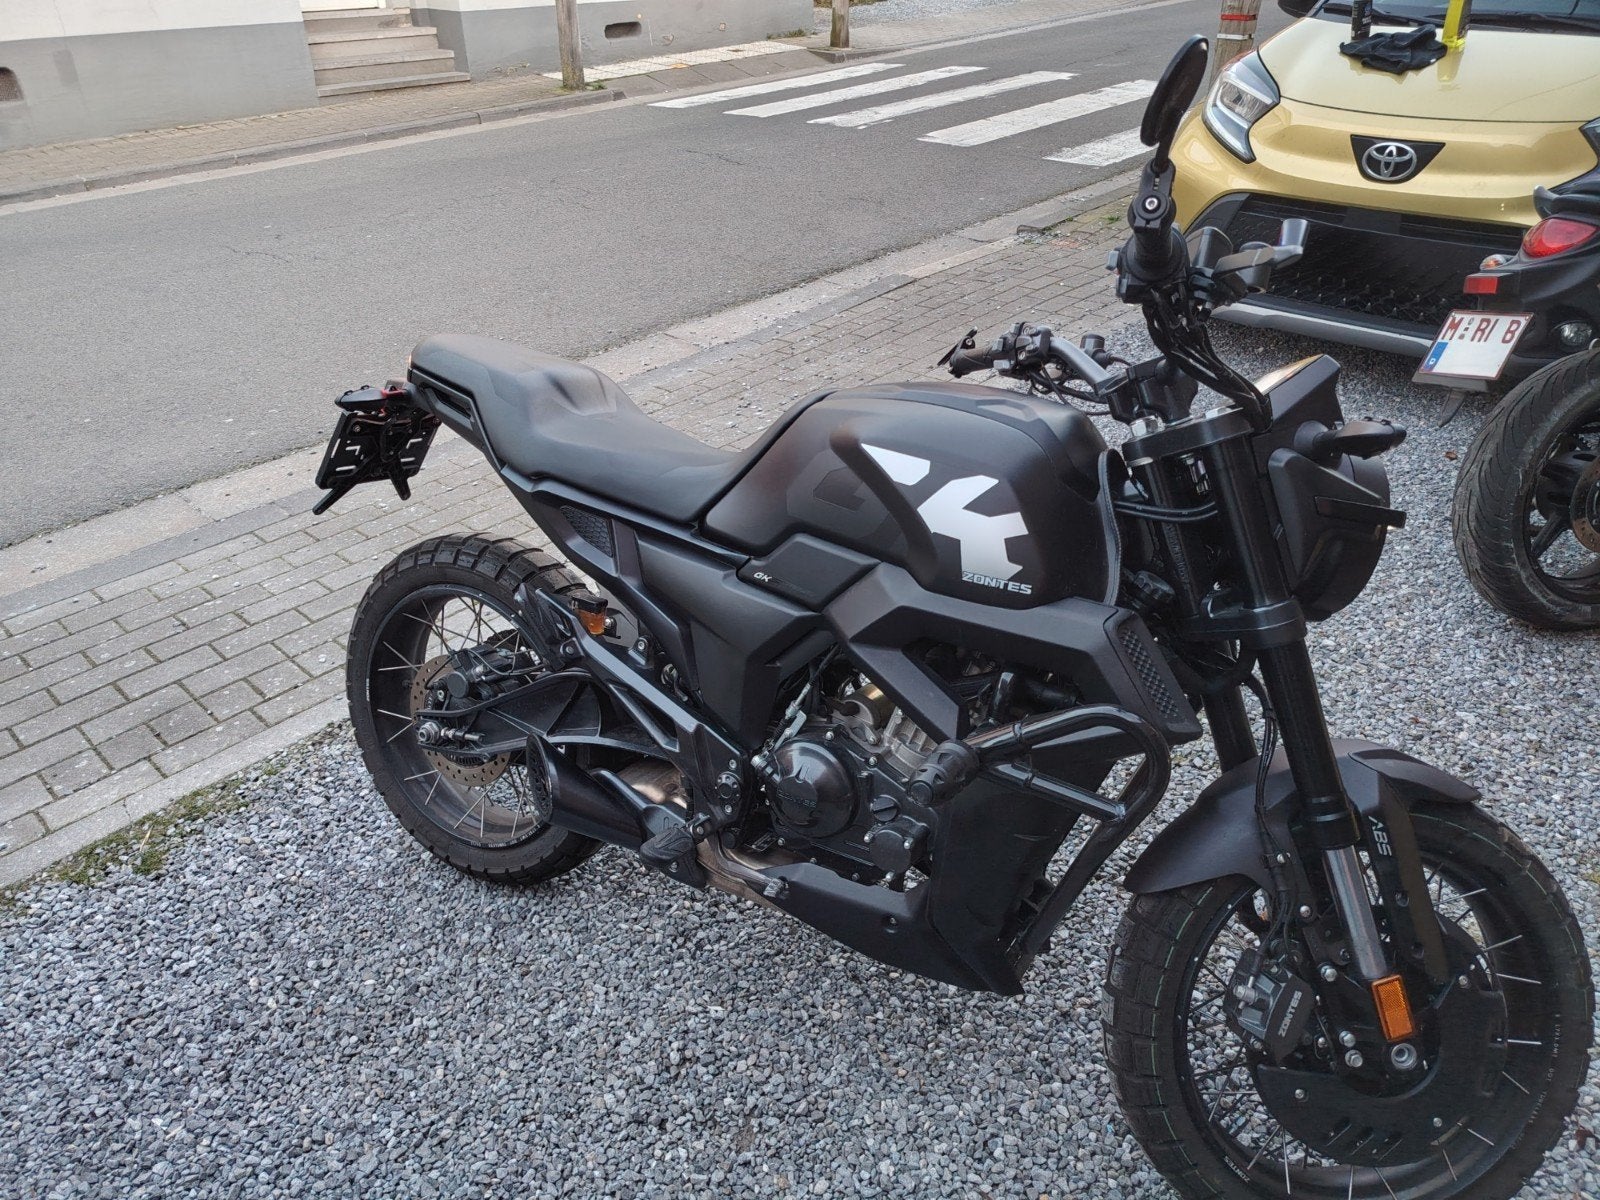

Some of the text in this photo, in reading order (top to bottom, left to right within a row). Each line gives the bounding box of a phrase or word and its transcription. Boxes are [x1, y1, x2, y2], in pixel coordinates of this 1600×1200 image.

[753, 572, 772, 582] GK
[962, 571, 1032, 595] ZONTES
[1368, 815, 1393, 856] ABS
[1278, 990, 1303, 1037] ZONTES
[1224, 1155, 1250, 1184] ZONTES
